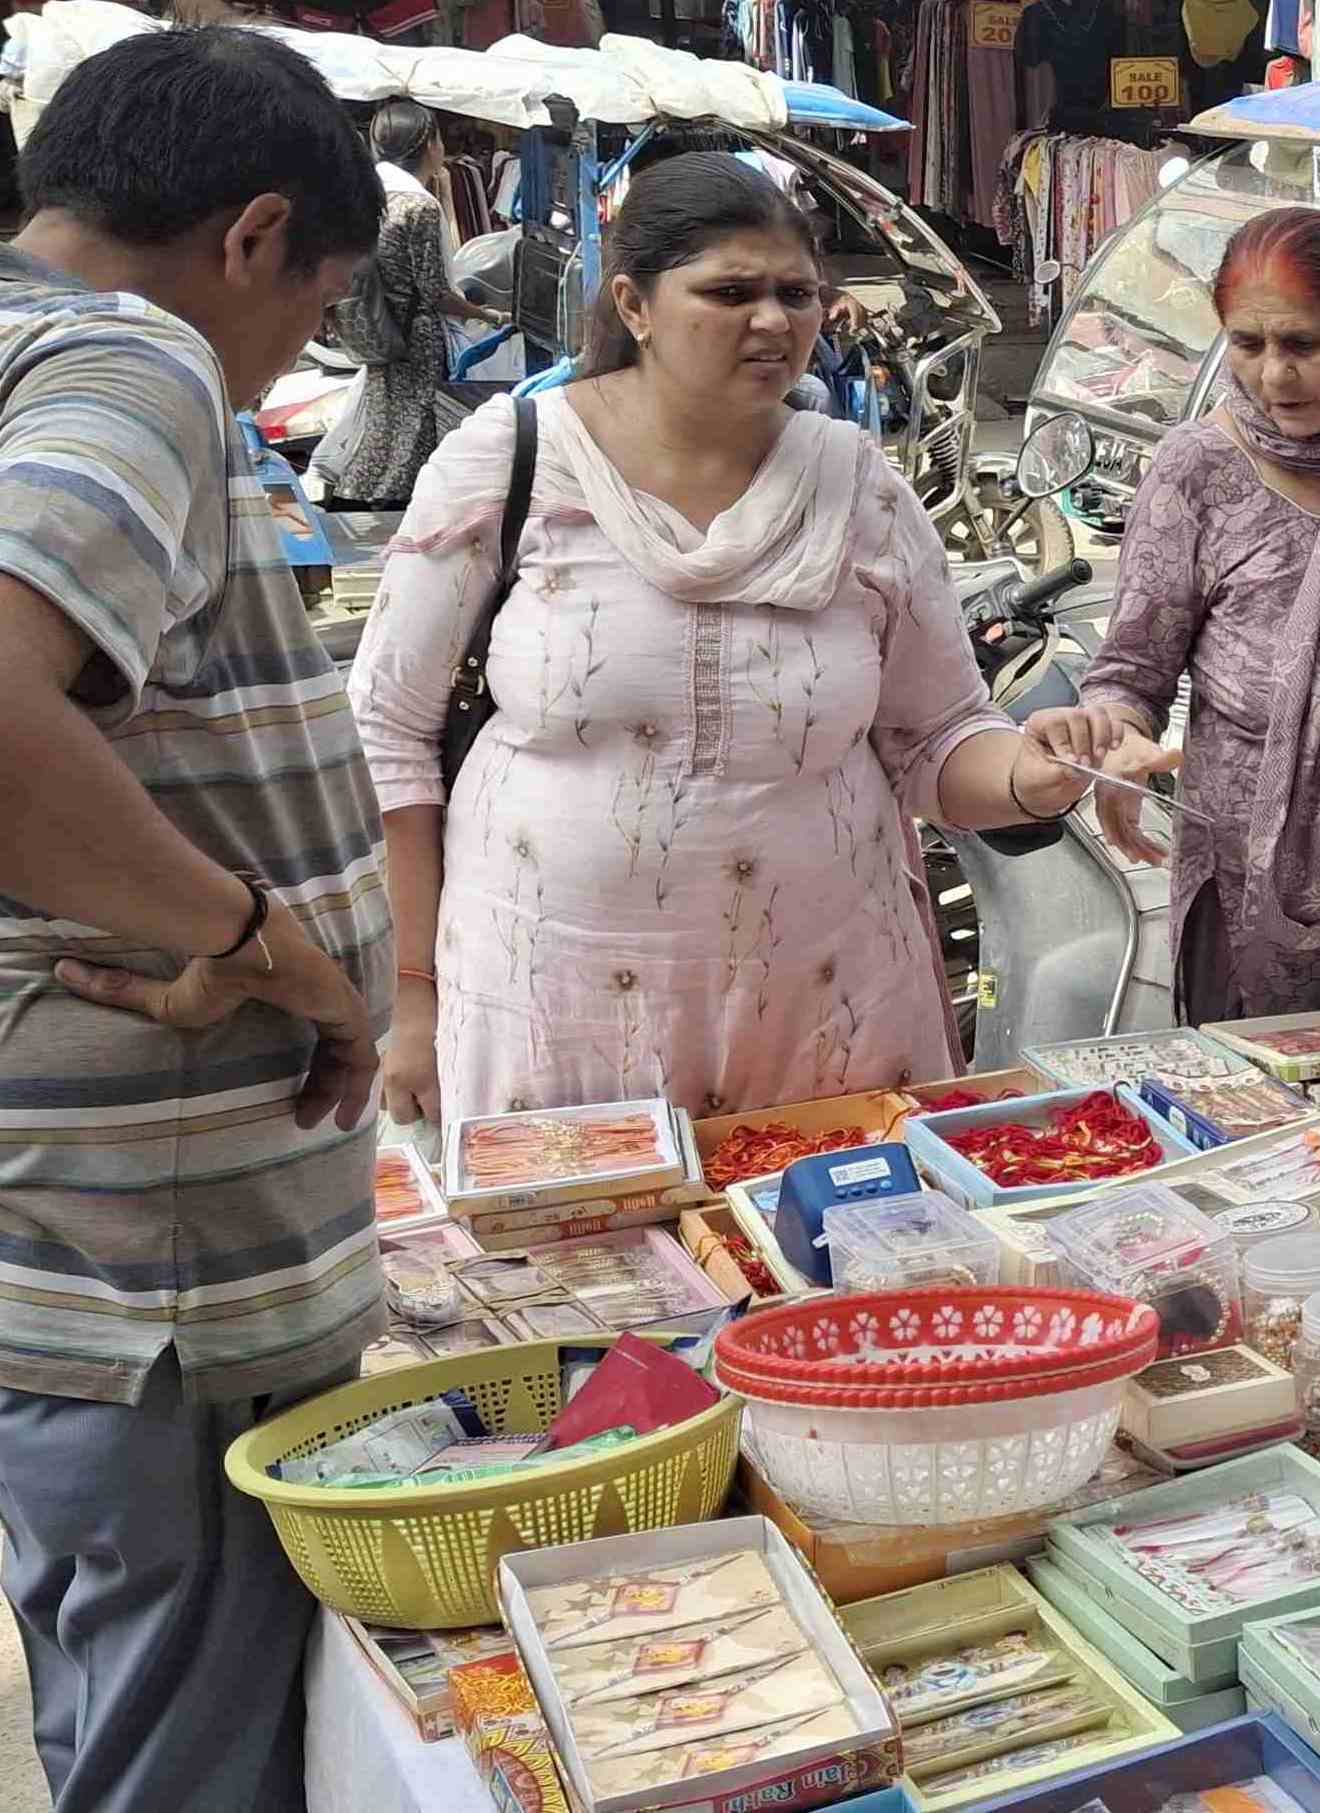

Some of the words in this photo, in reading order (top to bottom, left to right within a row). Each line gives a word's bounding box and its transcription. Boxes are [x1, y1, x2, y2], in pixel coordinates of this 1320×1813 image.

[1129, 72, 1162, 82] SALE
[1121, 85, 1169, 101] 100
[801, 1763, 853, 1790] Jain
